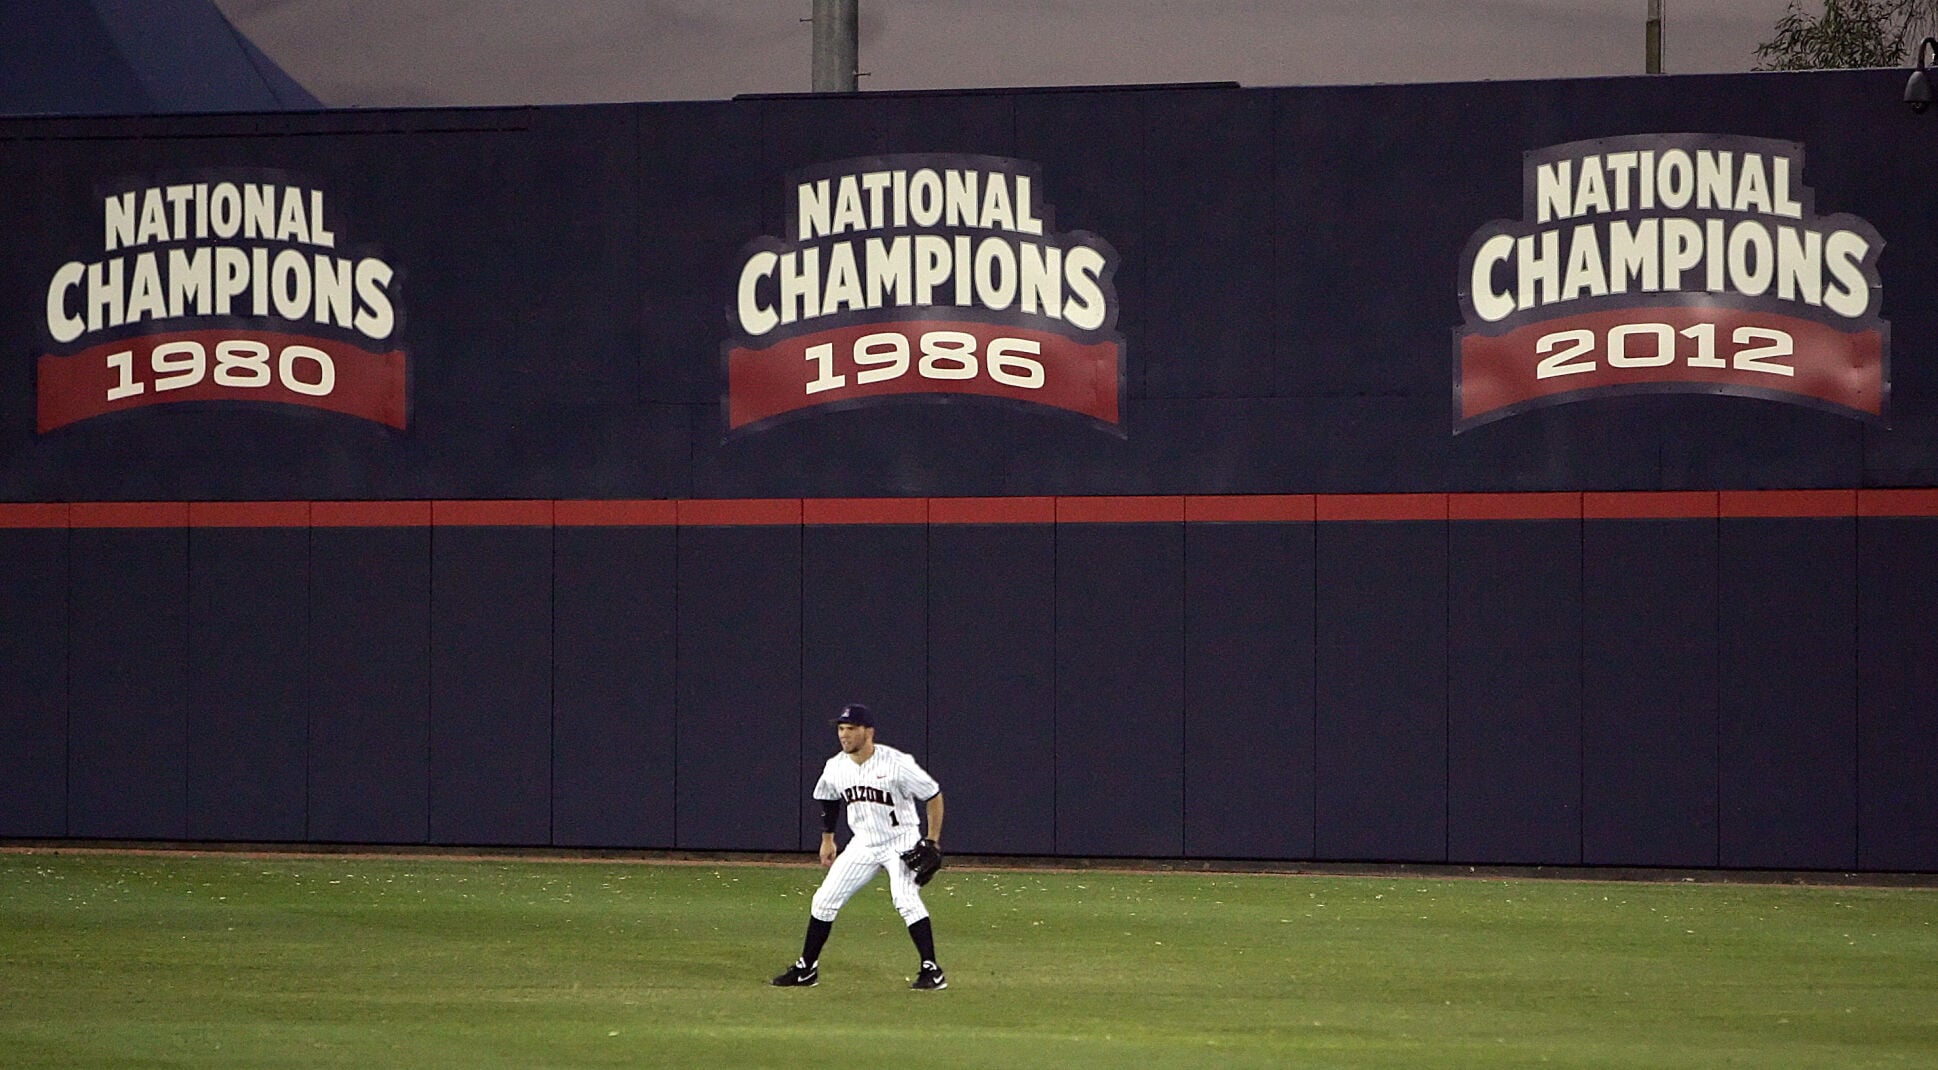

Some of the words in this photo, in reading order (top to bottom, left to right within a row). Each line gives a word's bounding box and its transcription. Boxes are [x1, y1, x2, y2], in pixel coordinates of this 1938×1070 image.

[105, 182, 334, 251] NATIONAL
[798, 168, 1043, 242] NATIONAL
[1536, 149, 1802, 224] NATIONAL
[46, 247, 395, 343] CHAMPIONS
[737, 235, 1107, 337] CHAMPIONS
[1470, 218, 1869, 322] CHAMPIONS
[106, 340, 336, 401] 1980
[804, 331, 1045, 395] 1986
[1535, 322, 1795, 380] 2012
[889, 810, 899, 827] 1
